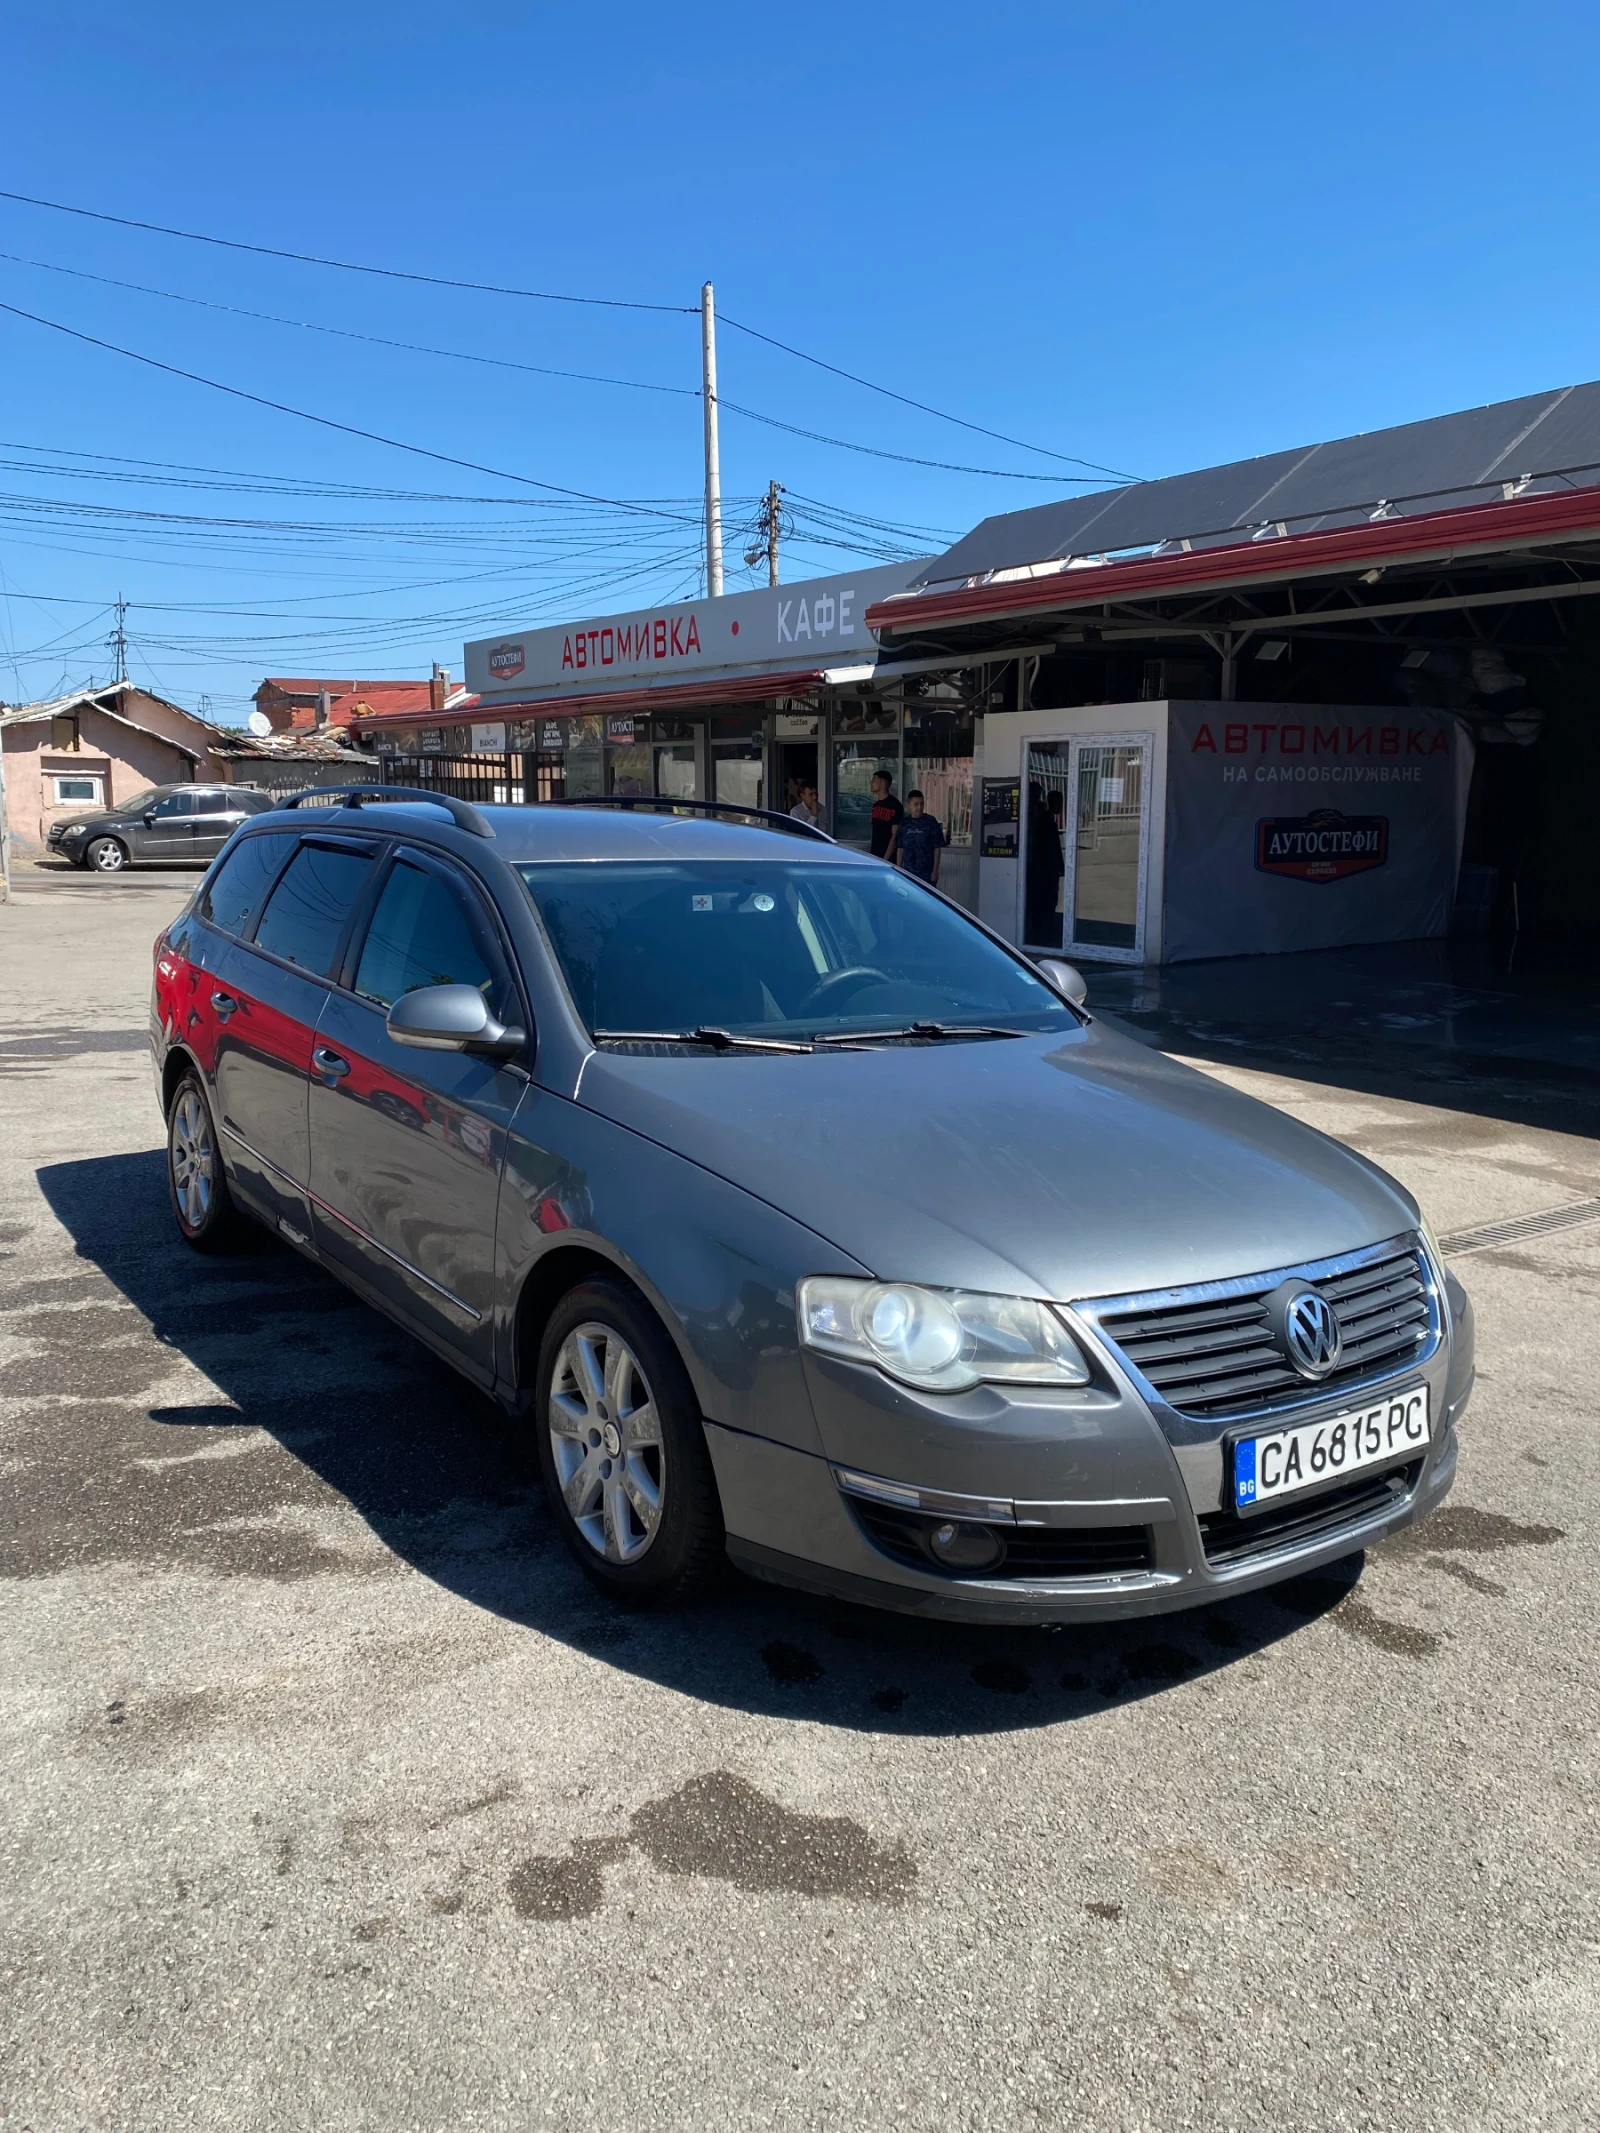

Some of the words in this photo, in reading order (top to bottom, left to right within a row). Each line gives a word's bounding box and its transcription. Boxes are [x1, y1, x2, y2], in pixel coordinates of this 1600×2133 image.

[562, 615, 701, 671] АВТОМИВКА
[777, 591, 855, 644] КАФЕ
[479, 739, 498, 747] BIANCHI
[1191, 724, 1449, 755] АВТОМИВКА
[1223, 766, 1249, 782] НА
[1254, 766, 1423, 783] САМООБСЛУЖВАНЕ
[1269, 830, 1380, 854] АУТОСТЕФИ
[1306, 867, 1337, 876] EXPRESS
[1239, 1479, 1255, 1497] BG
